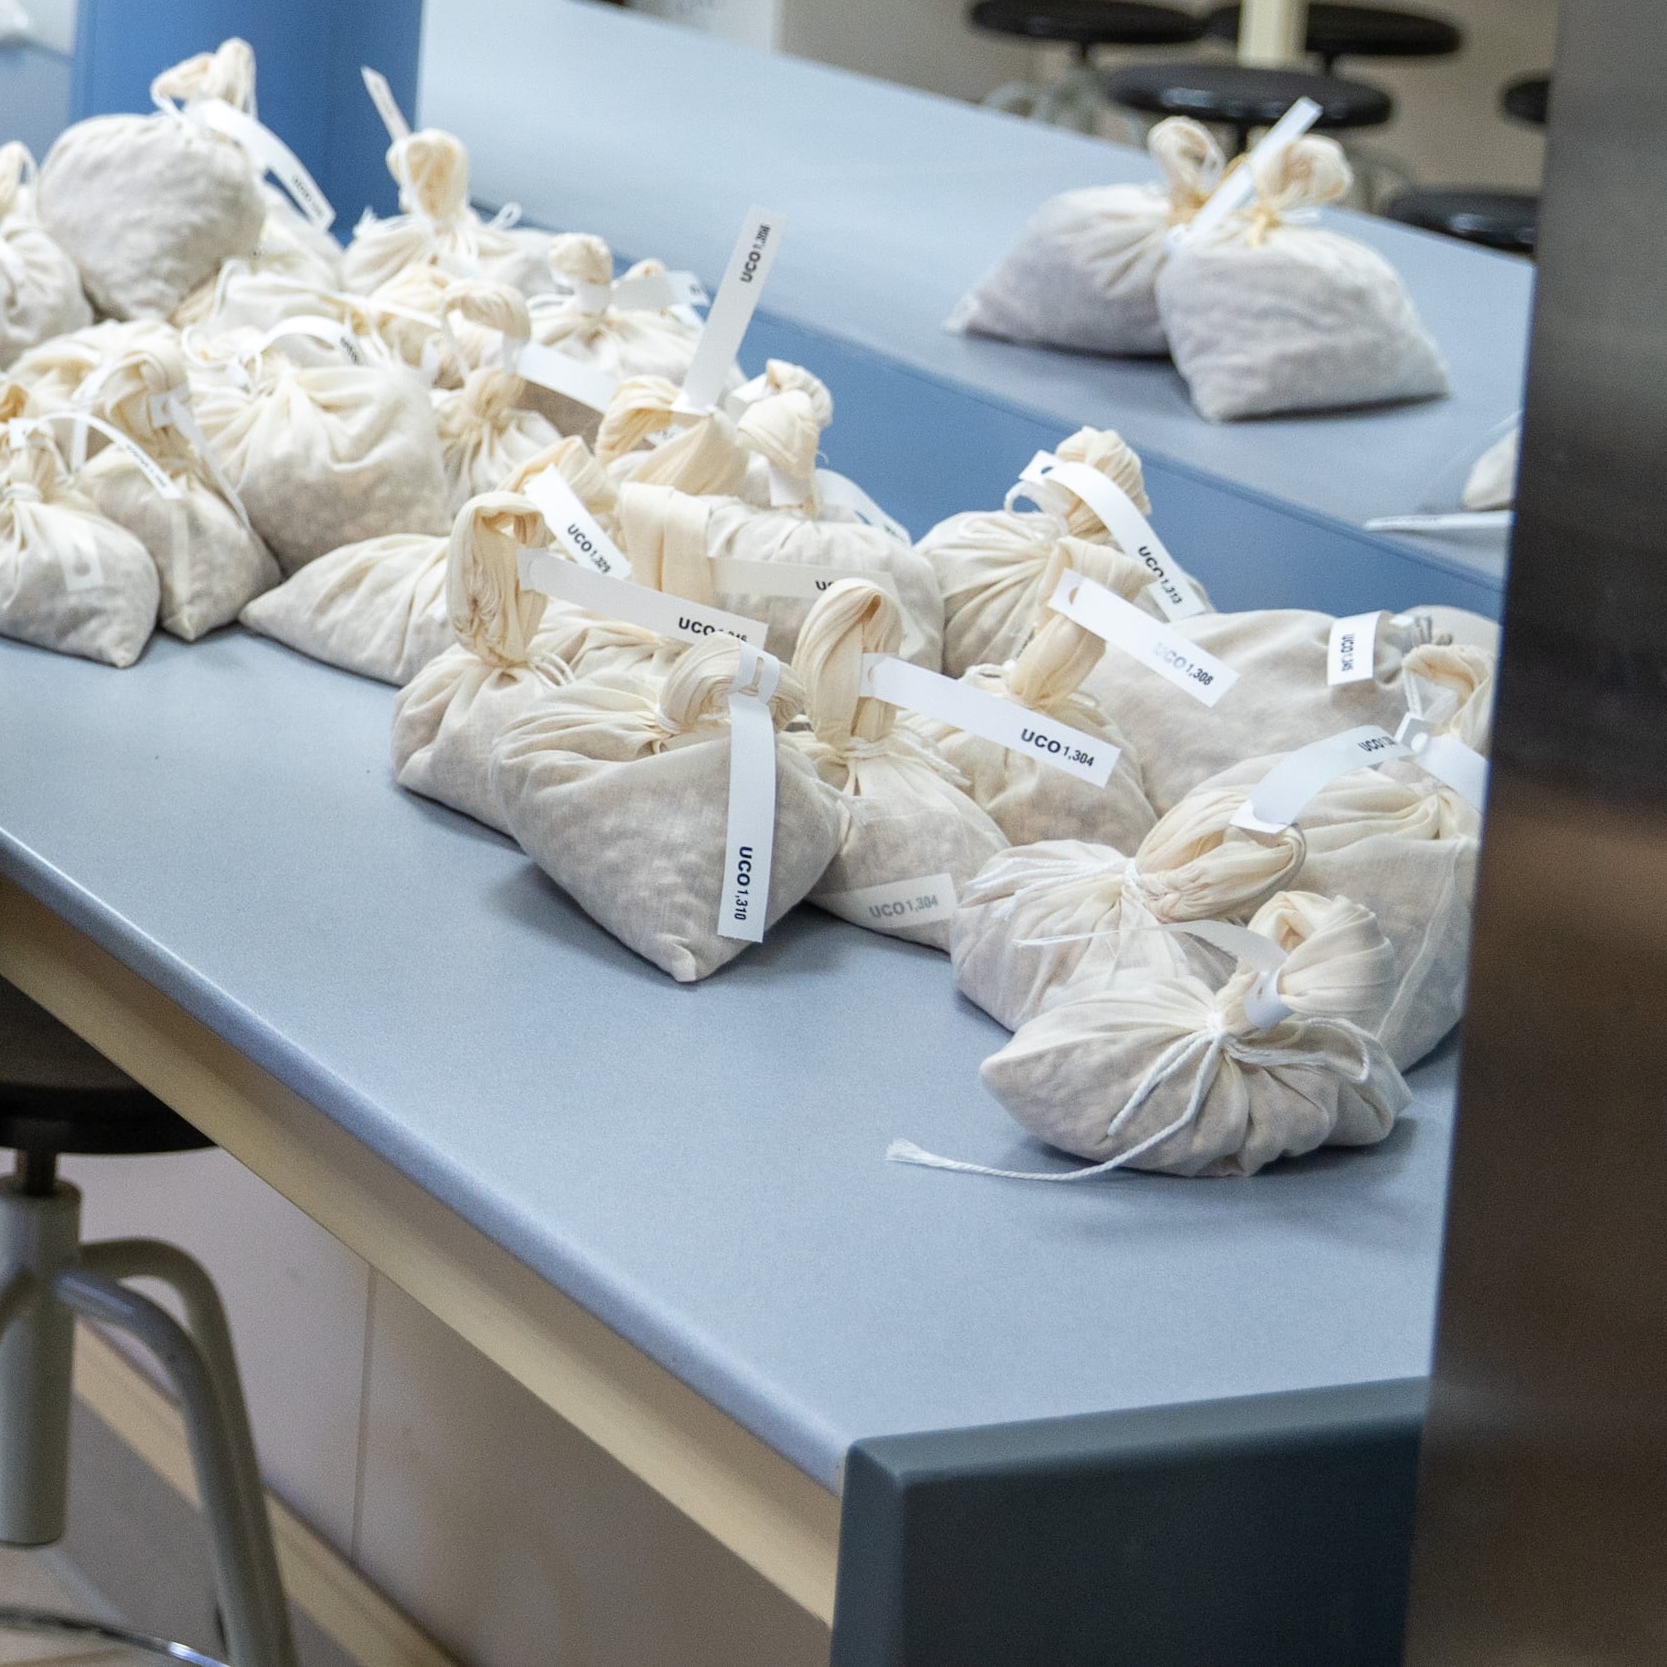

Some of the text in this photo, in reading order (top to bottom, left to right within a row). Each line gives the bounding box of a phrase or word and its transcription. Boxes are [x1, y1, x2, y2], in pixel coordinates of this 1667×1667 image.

[739, 250, 761, 283] UCO
[567, 523, 592, 552] UCO
[1138, 546, 1164, 578] UCO
[678, 617, 715, 636] UCO
[1020, 728, 1061, 754] UCO
[734, 846, 753, 921] UCO 1,310
[868, 902, 905, 918] UCO
